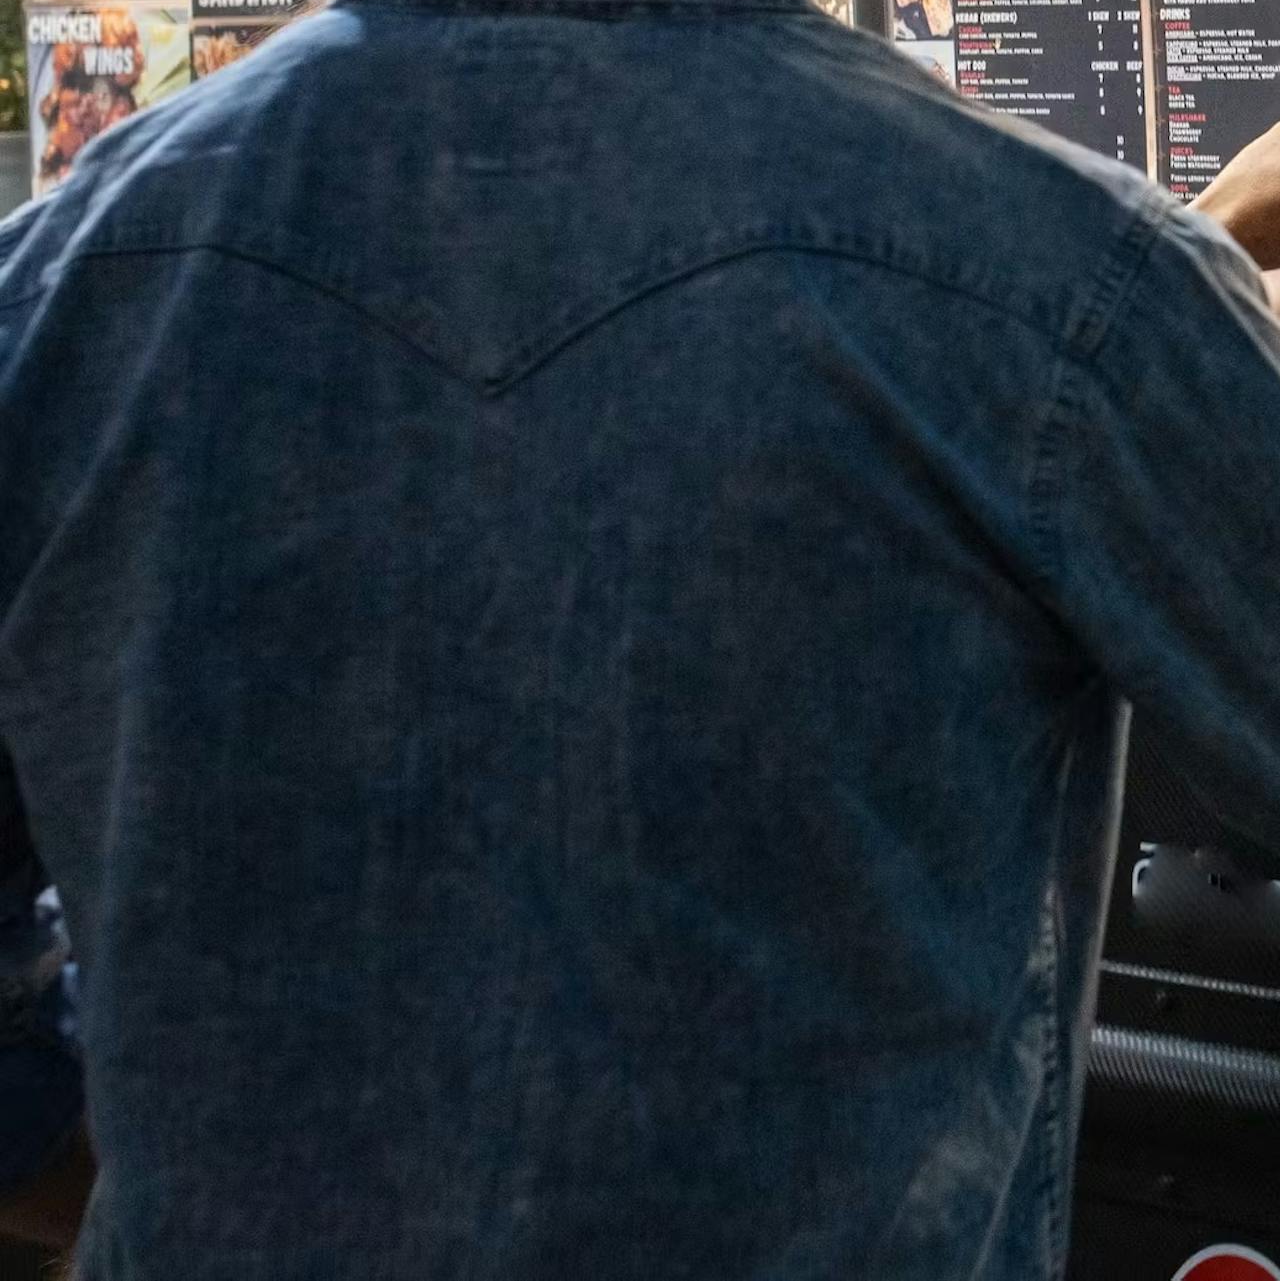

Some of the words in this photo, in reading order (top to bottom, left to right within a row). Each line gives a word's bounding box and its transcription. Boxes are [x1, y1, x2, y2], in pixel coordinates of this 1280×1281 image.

[955, 12, 979, 24] KEBAB
[980, 11, 1018, 24] (SKEWERS)
[1160, 8, 1190, 21] DRINKS
[28, 14, 102, 44] CHICKEN
[1165, 22, 1190, 30] COFFEE
[83, 47, 133, 76] WINGS
[957, 60, 971, 71] HOT
[972, 60, 986, 71] DOG
[1091, 61, 1119, 72] CHICKEN
[1126, 61, 1142, 72] BEEF
